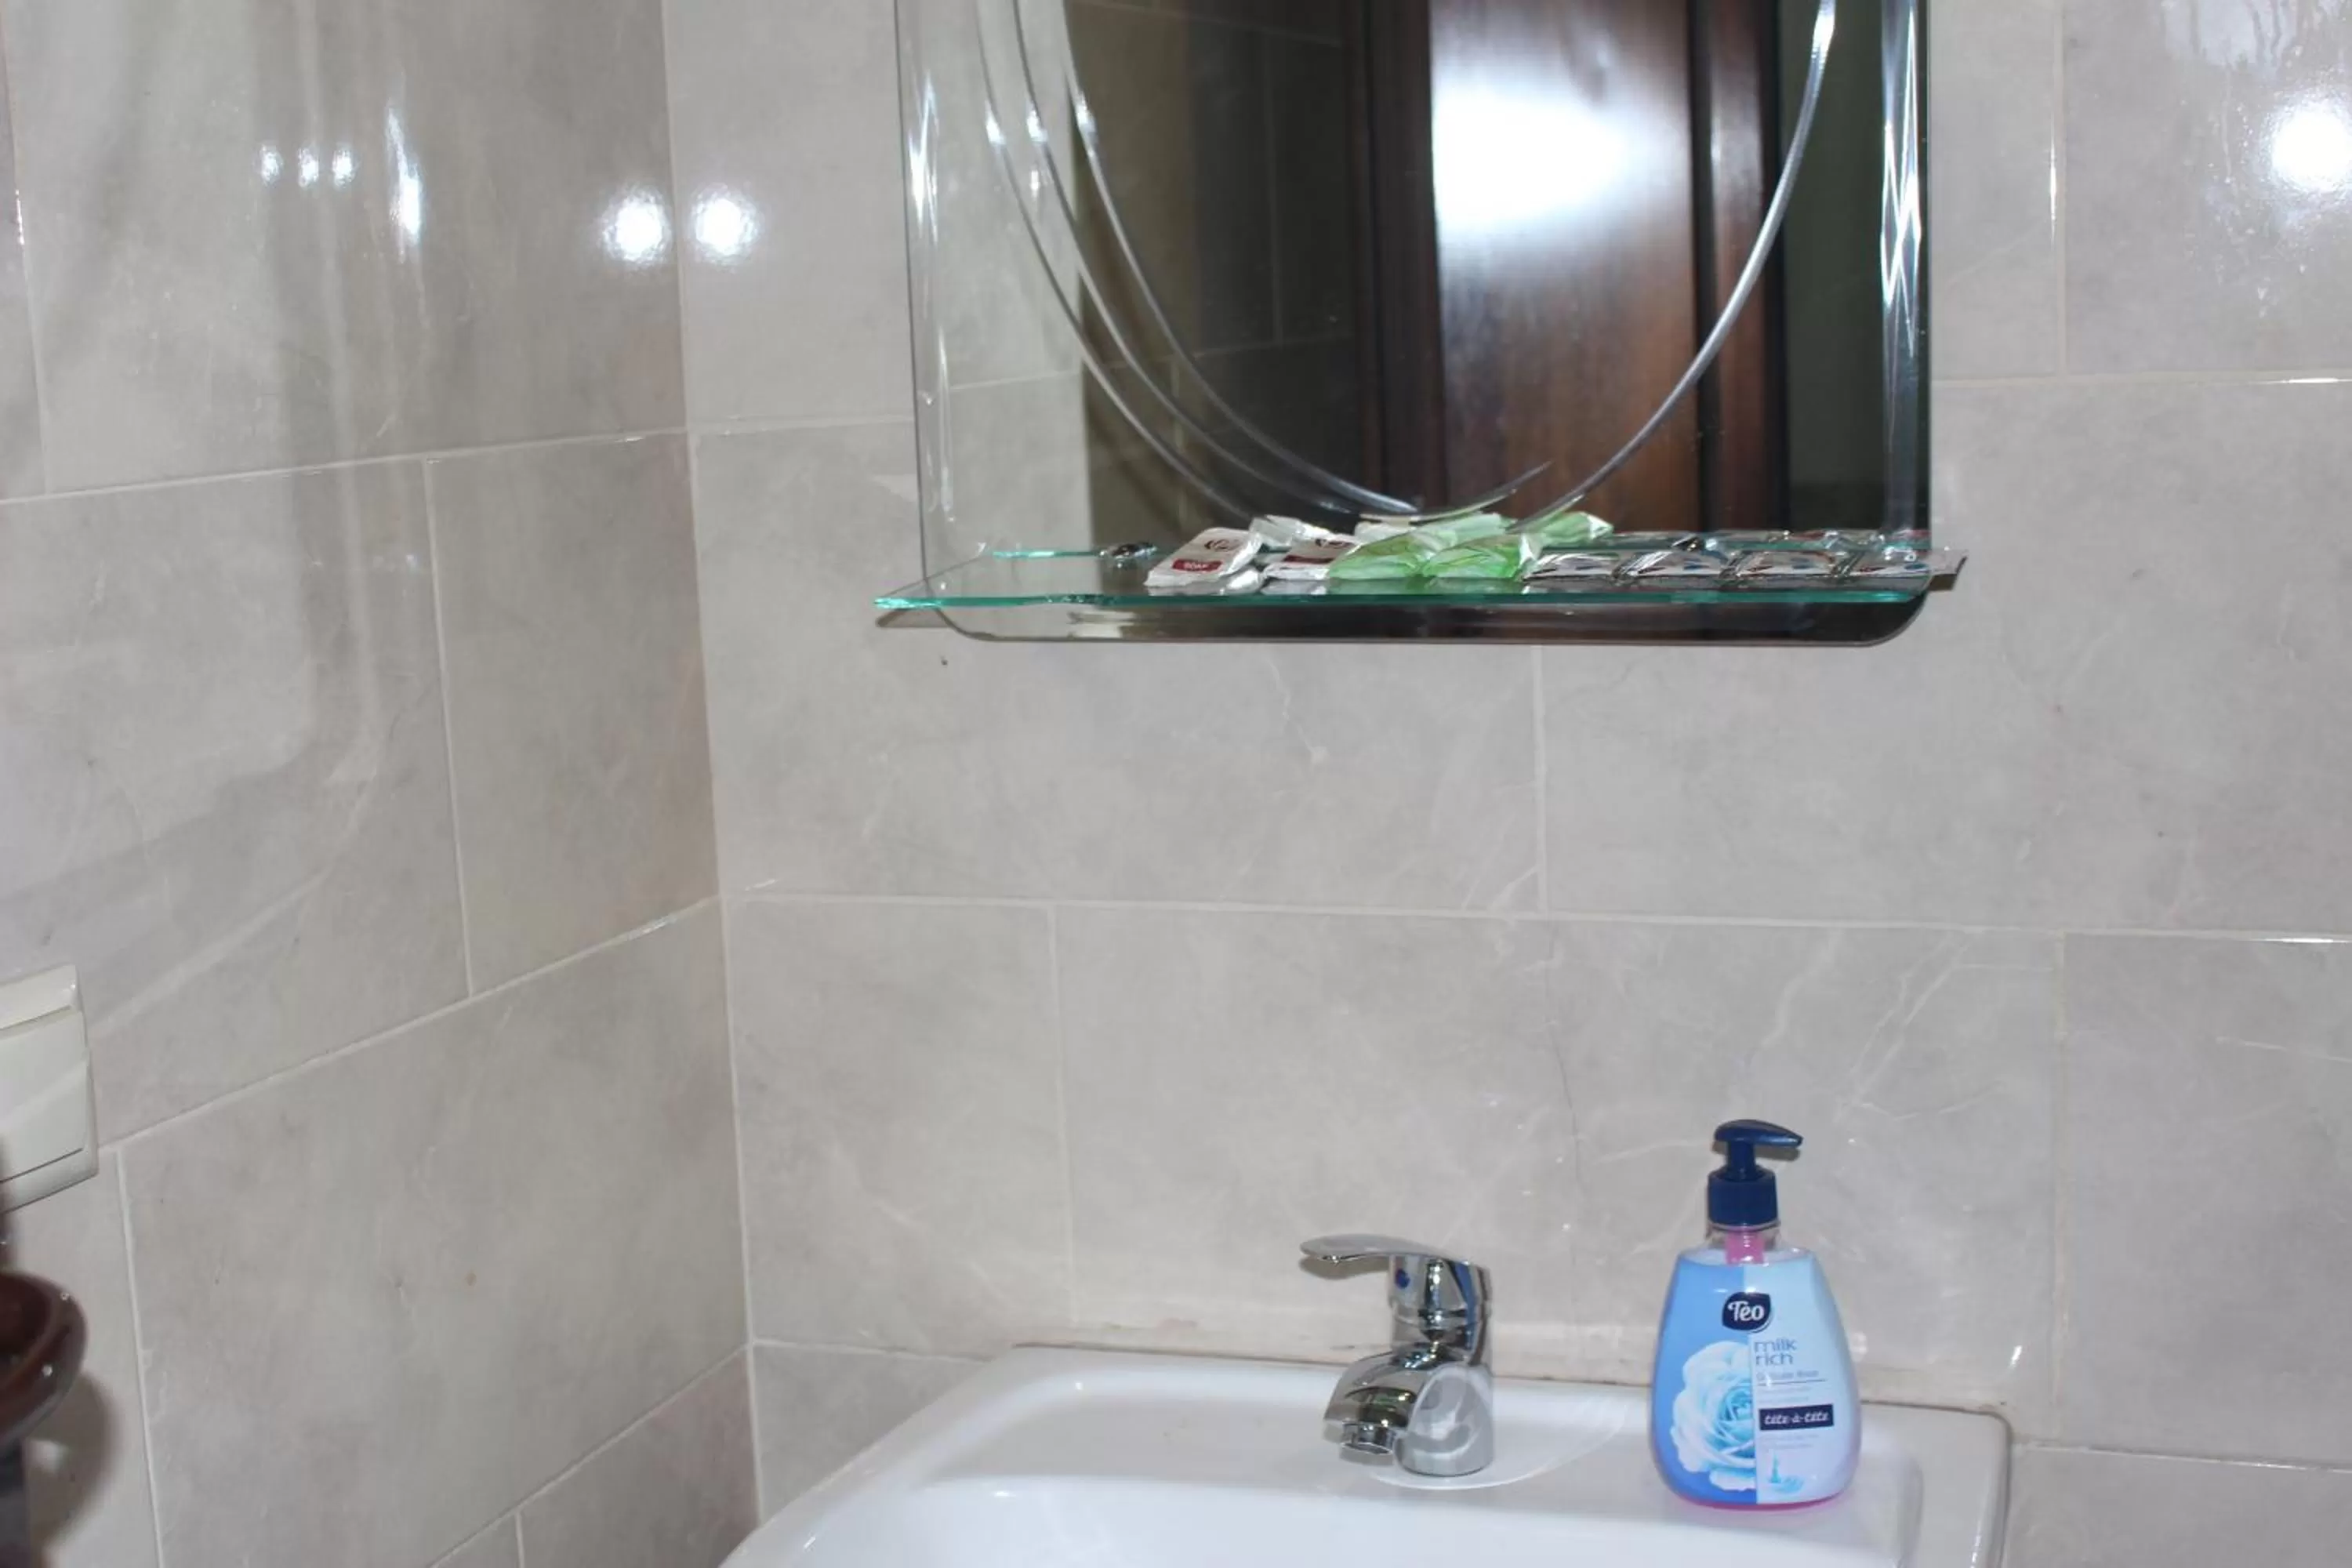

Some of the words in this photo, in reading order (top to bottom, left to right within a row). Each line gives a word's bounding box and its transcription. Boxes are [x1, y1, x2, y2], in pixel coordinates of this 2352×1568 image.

[1727, 1301, 1765, 1322] Teo
[1754, 1338, 1797, 1352] milk
[1755, 1352, 1794, 1366] rich
